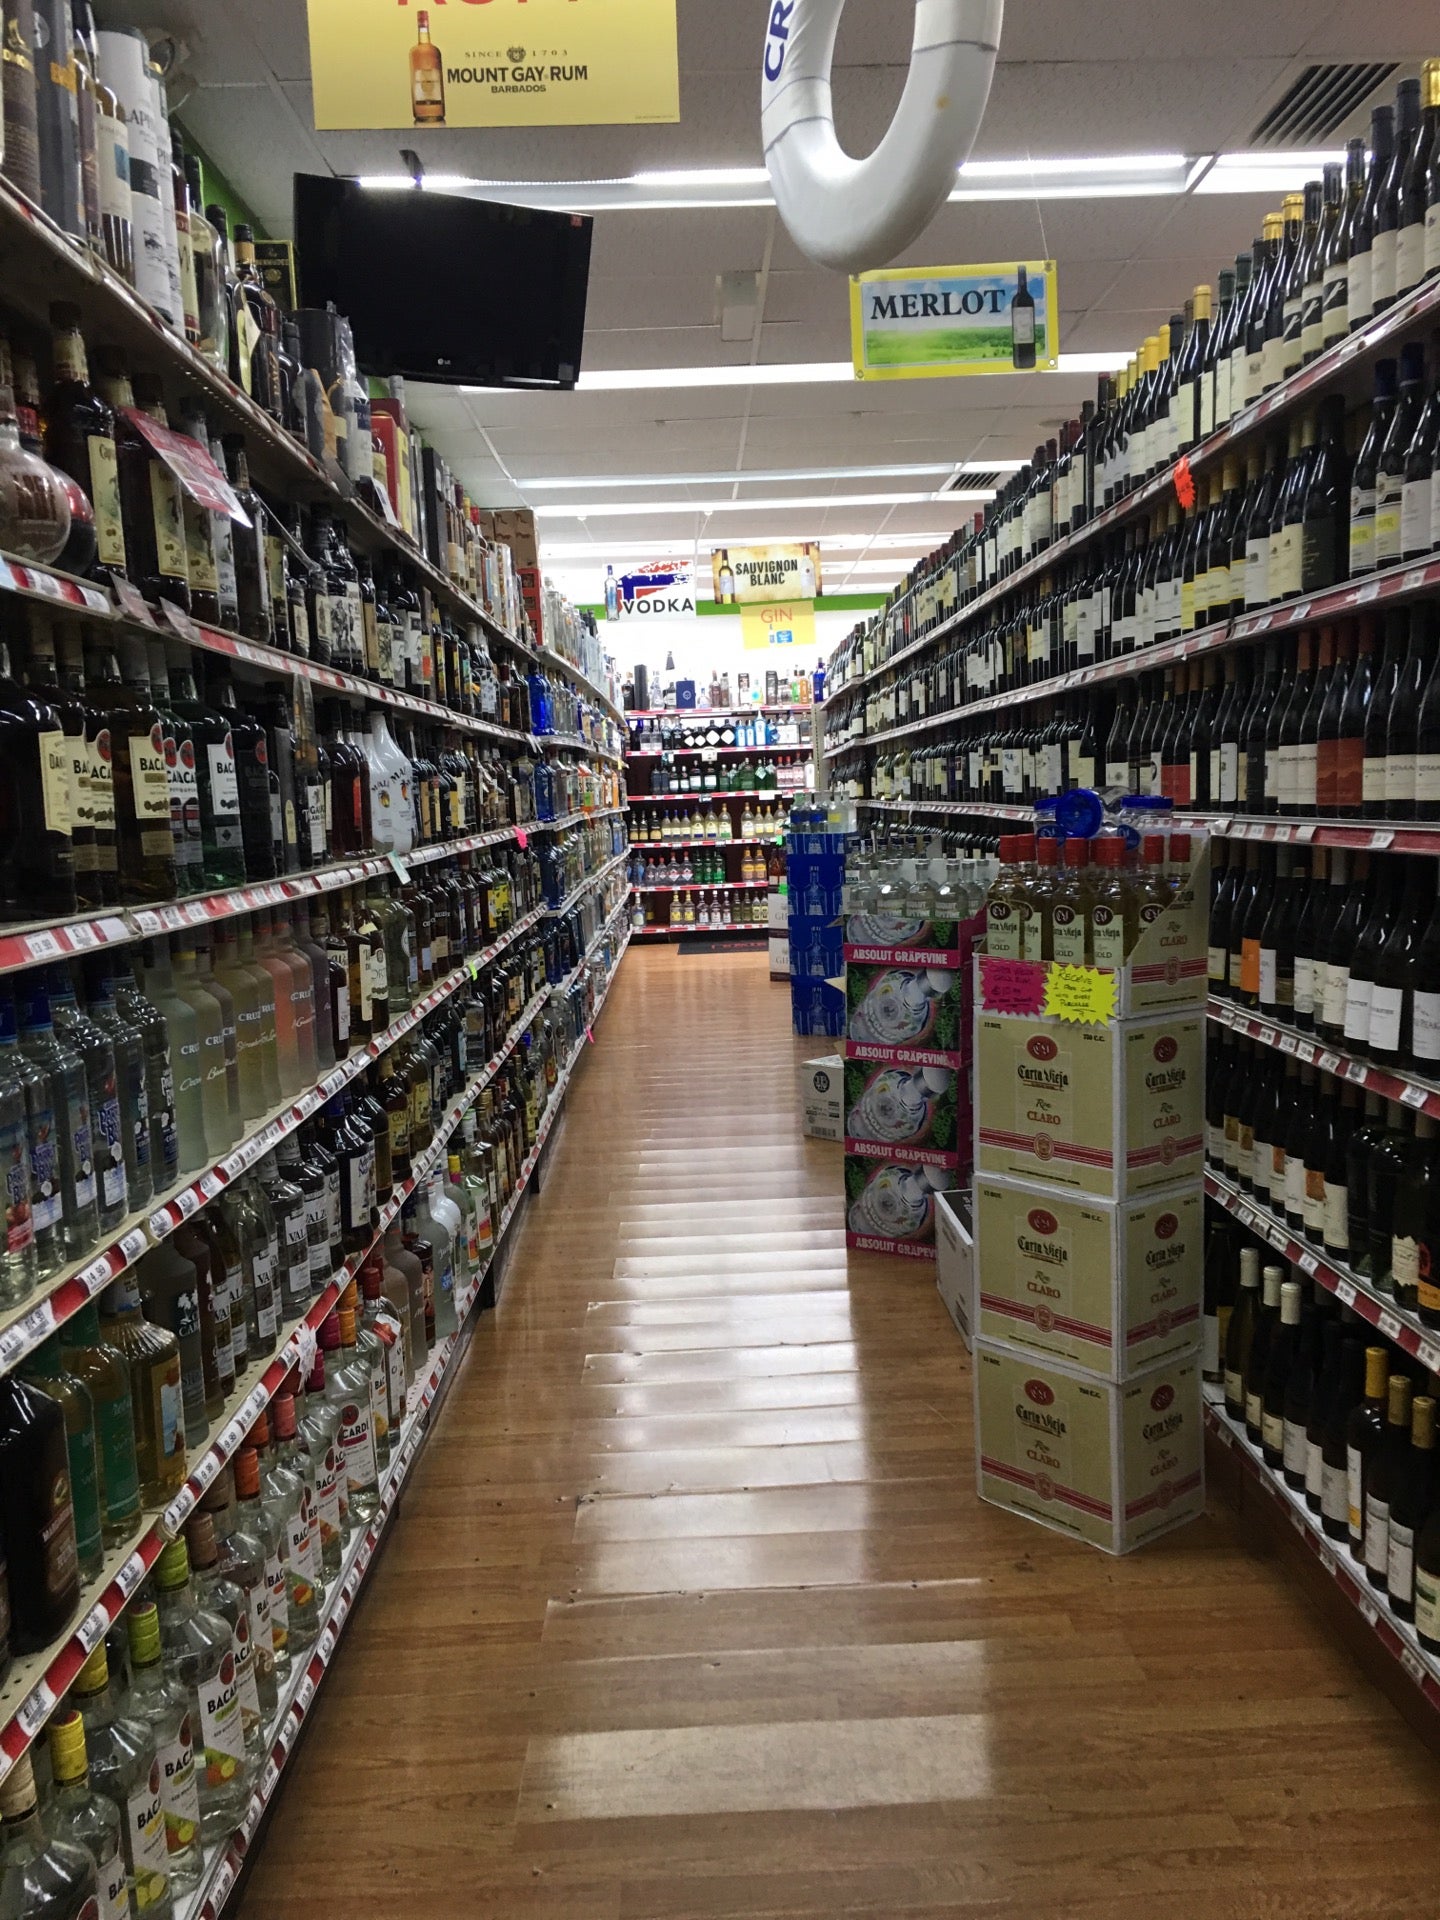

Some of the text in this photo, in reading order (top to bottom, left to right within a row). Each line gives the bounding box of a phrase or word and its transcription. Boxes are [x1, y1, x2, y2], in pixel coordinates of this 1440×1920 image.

[464, 51, 502, 59] SINCE
[447, 65, 588, 84] MOUNT GAY RUM
[491, 84, 547, 94] BARBADOS
[870, 289, 1006, 320] MERLOT
[735, 559, 798, 576] SAUVIGNON
[750, 572, 785, 586] BLANC
[622, 597, 694, 615] VODKA
[760, 607, 793, 624] GIN
[1160, 935, 1188, 947] CLARO
[853, 949, 948, 965] ABSOLUT GRÄPEVINE
[855, 1046, 894, 1060] ABSOLUT
[1017, 1064, 1042, 1081] Carta
[1042, 1068, 1069, 1087] Vieja
[1027, 1110, 1061, 1125] CLARO
[854, 1142, 947, 1166] ABSOLUT GRÄPEVINE
[856, 1237, 895, 1252] ABSOLUT
[1017, 1235, 1068, 1263] Carta Vieja
[1026, 1281, 1061, 1299] CLARO
[1015, 1403, 1067, 1435] Carta Vieja
[1026, 1449, 1061, 1469] CLARO
